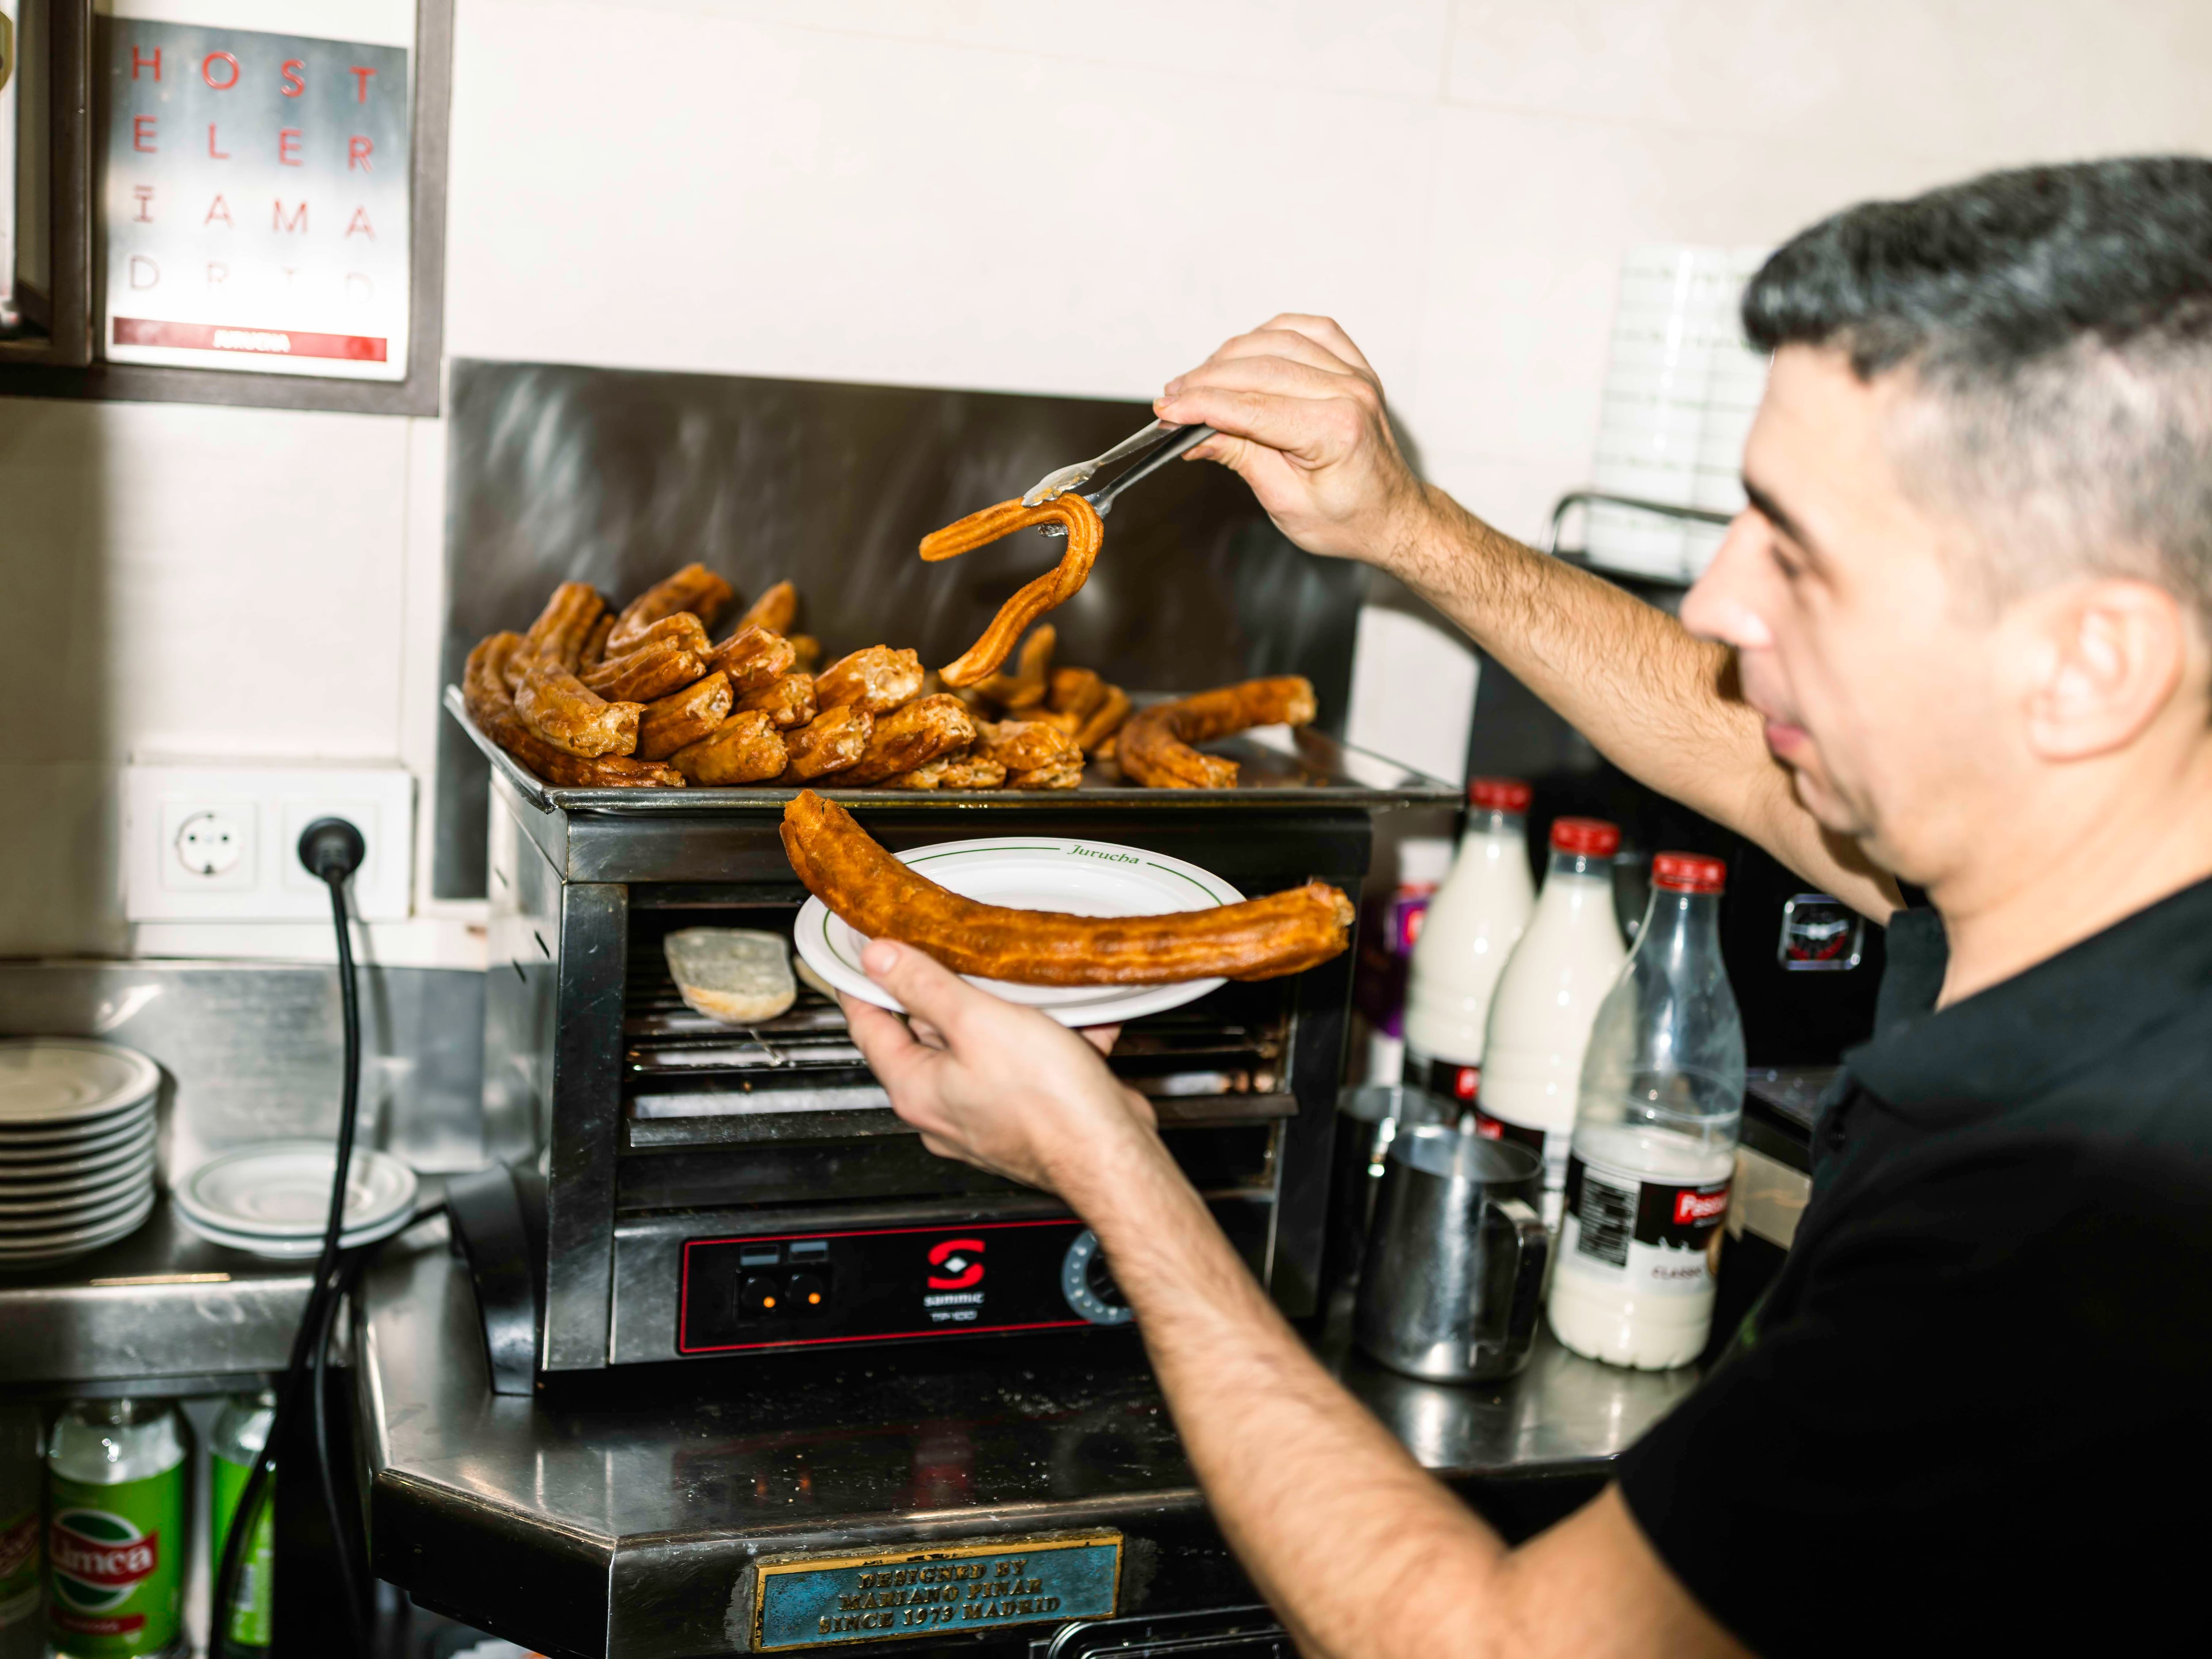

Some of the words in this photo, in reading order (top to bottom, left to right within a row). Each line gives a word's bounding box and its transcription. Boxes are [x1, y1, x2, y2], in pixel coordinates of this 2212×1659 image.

[1067, 844, 1140, 864] Jurucha
[857, 1563, 987, 1589] DESIGNED
[994, 1559, 1029, 1577] BY
[837, 1584, 960, 1611] MARIANO
[818, 1611, 895, 1634] SINCE
[903, 1605, 954, 1626] 1973
[961, 1596, 1061, 1620] MADRID
